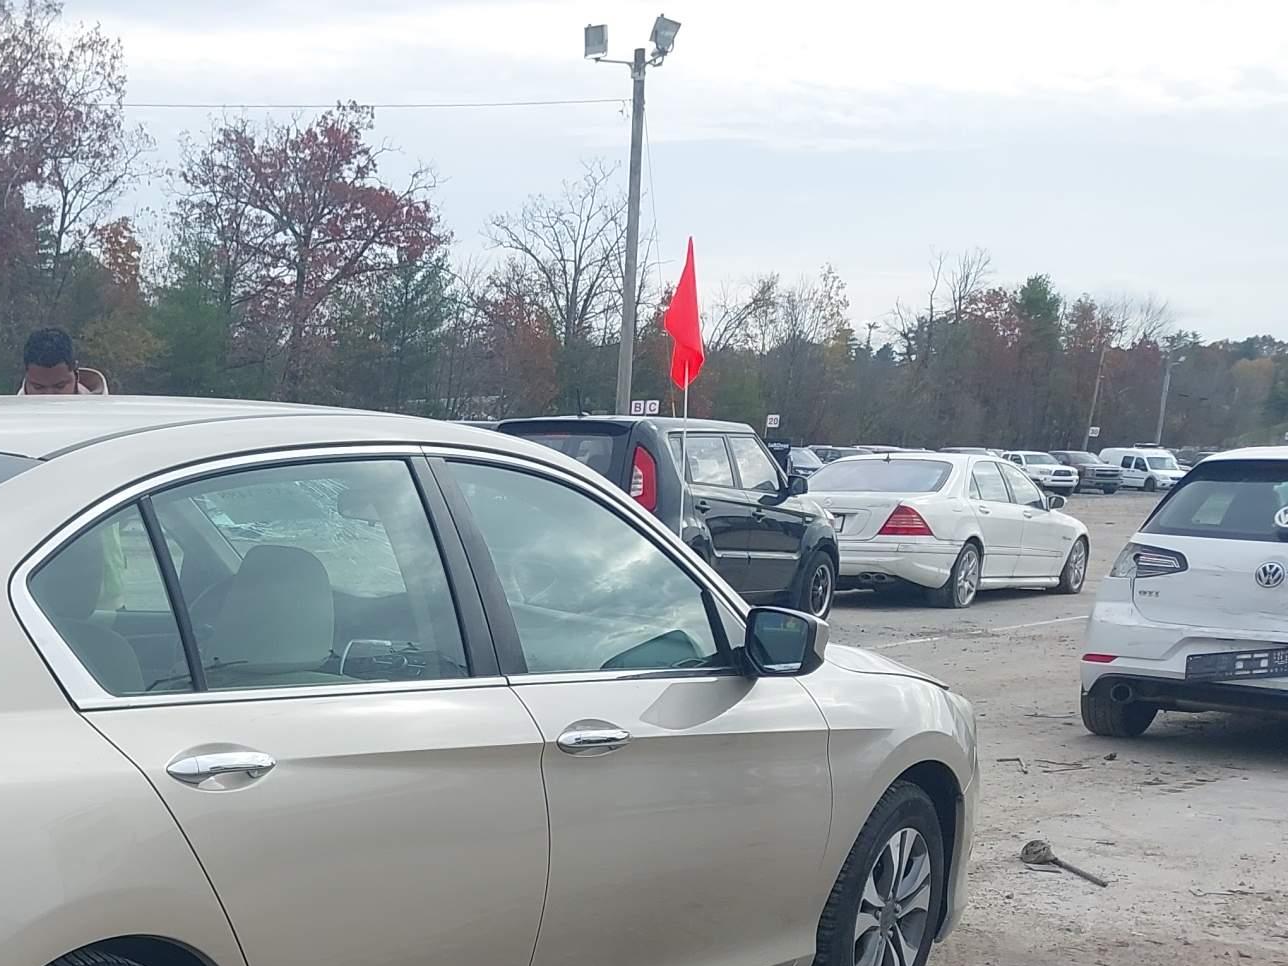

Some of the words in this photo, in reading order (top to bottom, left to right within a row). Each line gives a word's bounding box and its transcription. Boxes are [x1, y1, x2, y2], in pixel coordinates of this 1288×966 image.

[634, 402, 642, 412] B
[648, 402, 657, 412] C
[768, 417, 779, 425] 20
